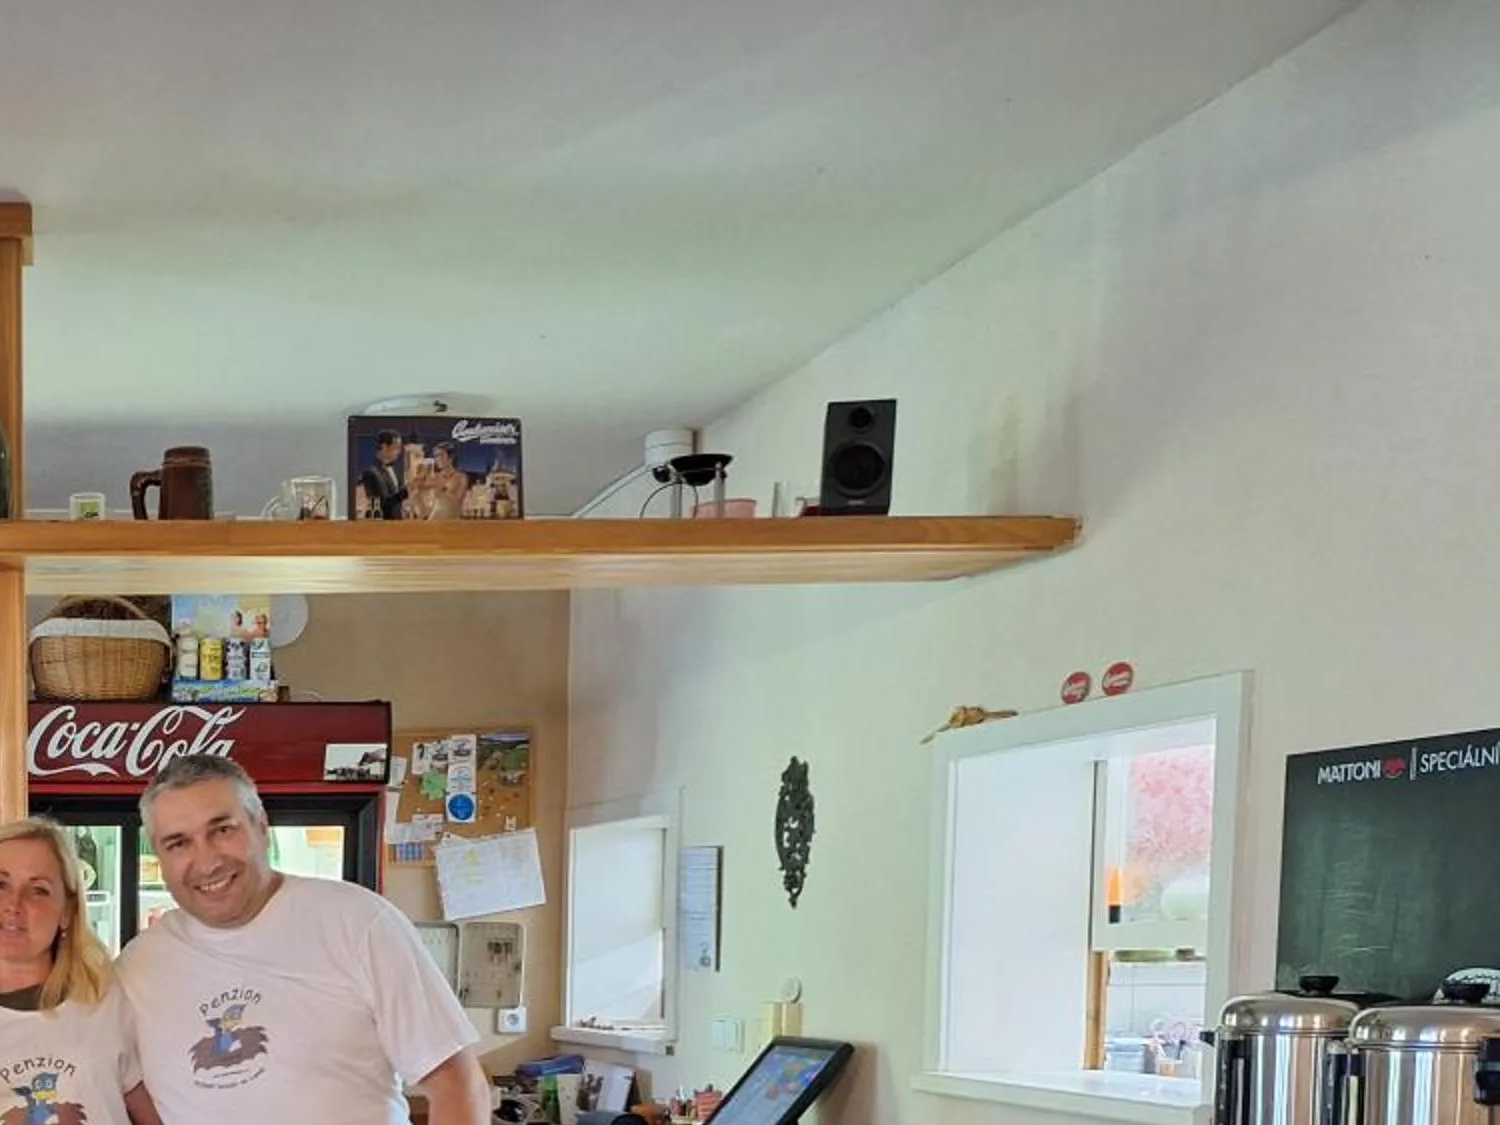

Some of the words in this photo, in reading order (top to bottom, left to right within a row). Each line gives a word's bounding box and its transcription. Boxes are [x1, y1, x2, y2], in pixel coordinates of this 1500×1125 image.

[26, 705, 247, 777] Coca-Cola
[1317, 760, 1381, 785] MATTONI
[1420, 741, 1500, 773] SPECIÁLNÍ
